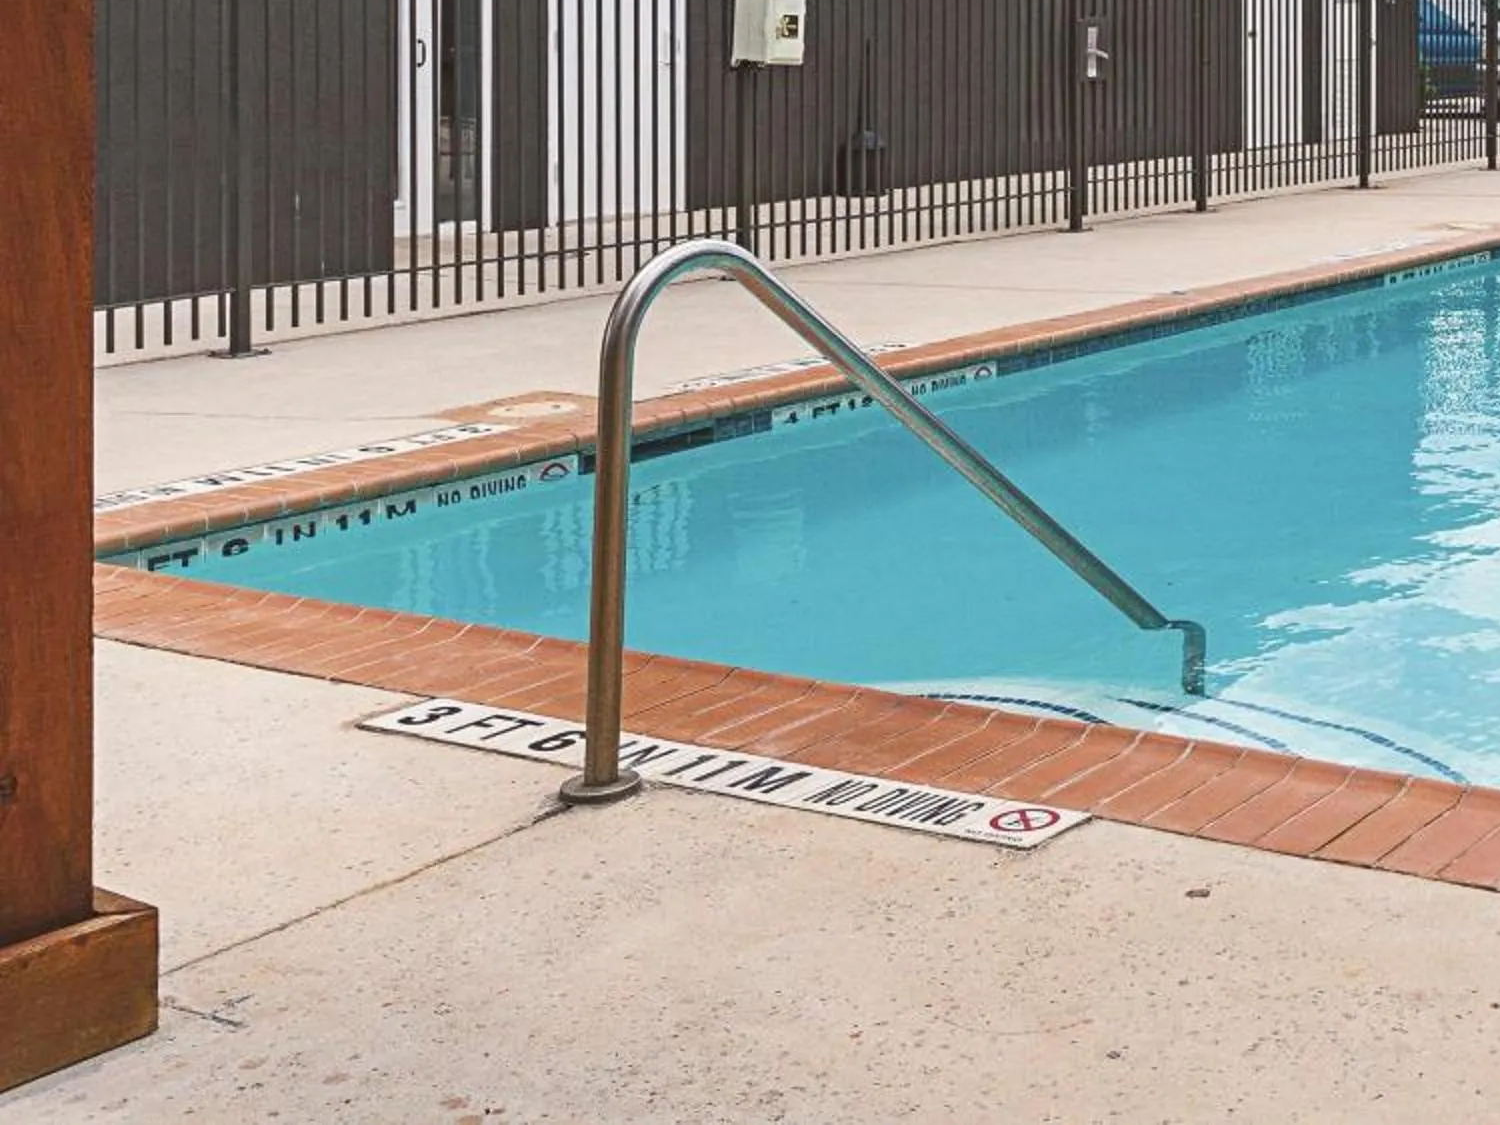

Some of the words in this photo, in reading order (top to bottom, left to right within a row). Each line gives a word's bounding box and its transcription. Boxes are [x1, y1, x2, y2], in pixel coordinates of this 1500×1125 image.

[275, 521, 317, 545] IN
[437, 490, 462, 508] NO
[470, 474, 528, 501] DIVING
[398, 706, 462, 725] 3
[445, 714, 544, 741] FT
[527, 730, 588, 752] 6
[803, 779, 878, 806] NO
[853, 788, 984, 826] DIVING
